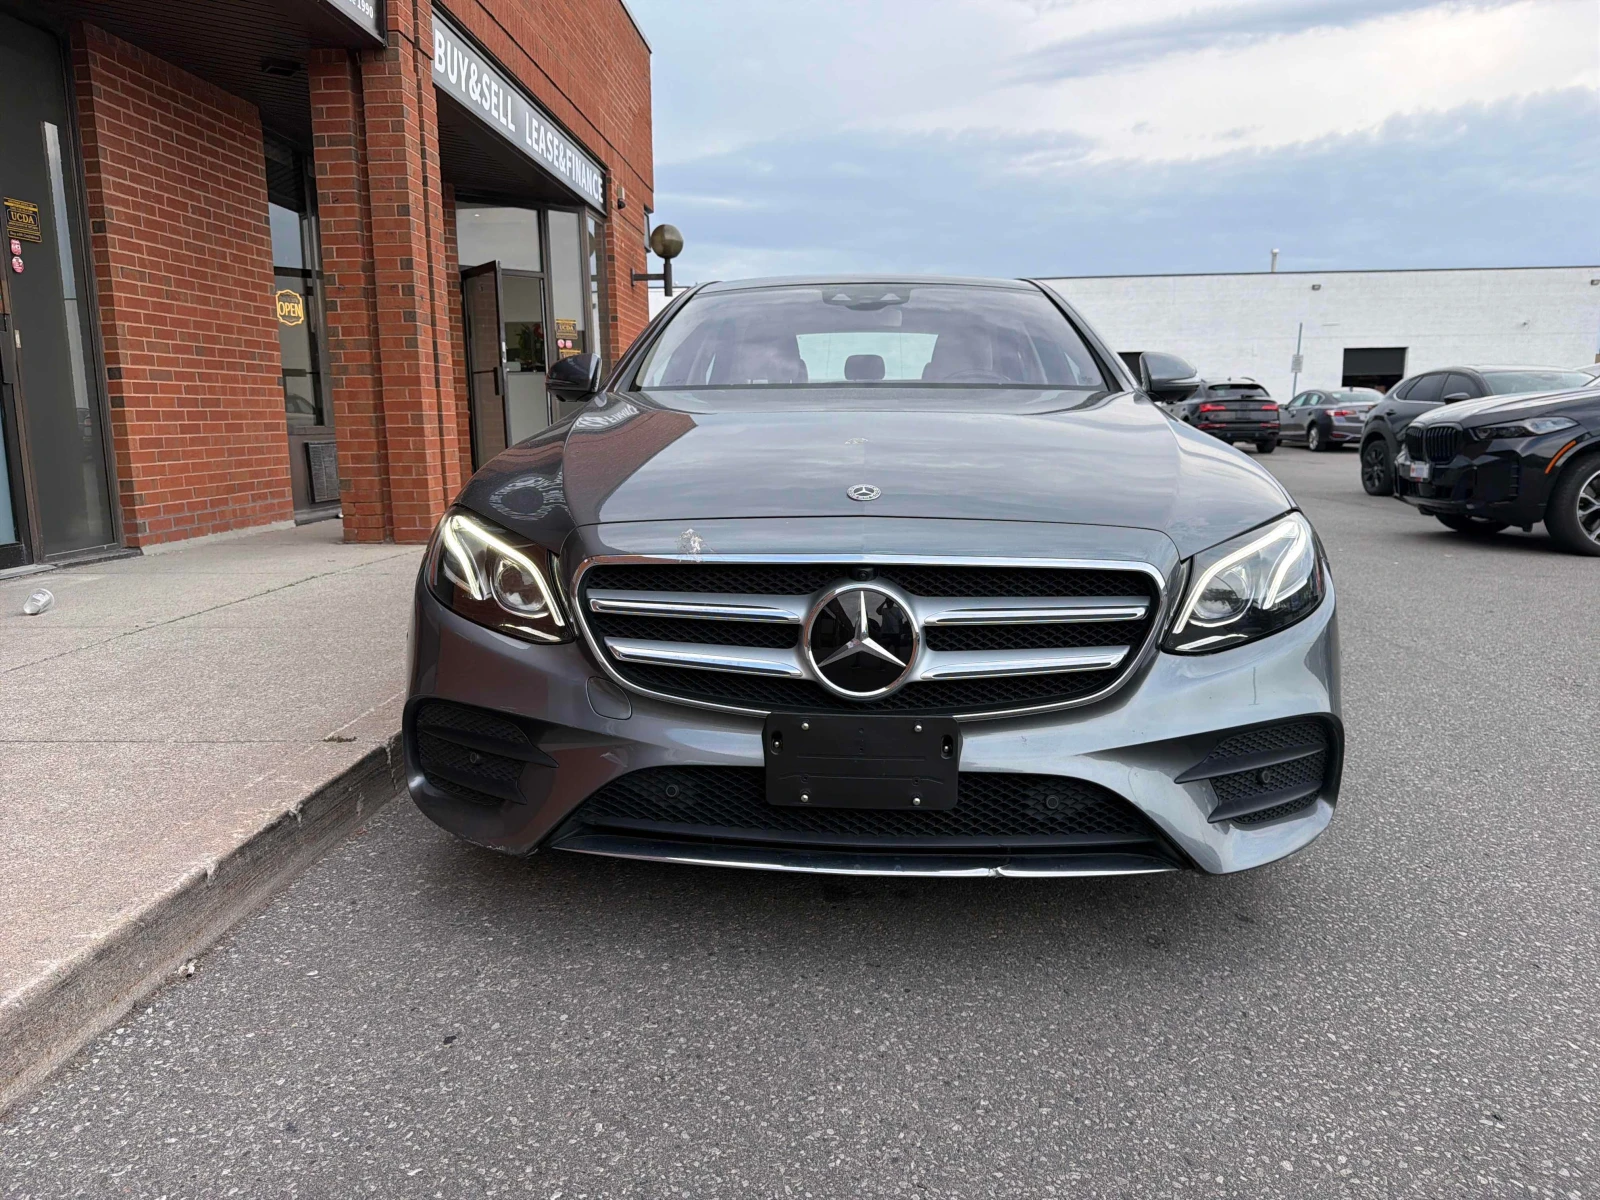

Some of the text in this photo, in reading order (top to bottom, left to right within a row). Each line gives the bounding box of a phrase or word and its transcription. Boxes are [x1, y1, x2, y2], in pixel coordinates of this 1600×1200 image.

[357, 0, 374, 19] 1990
[434, 28, 604, 204] BUY&SELL LEASE&FINANCE
[11, 211, 35, 224] UCDA
[278, 301, 302, 318] OPEN
